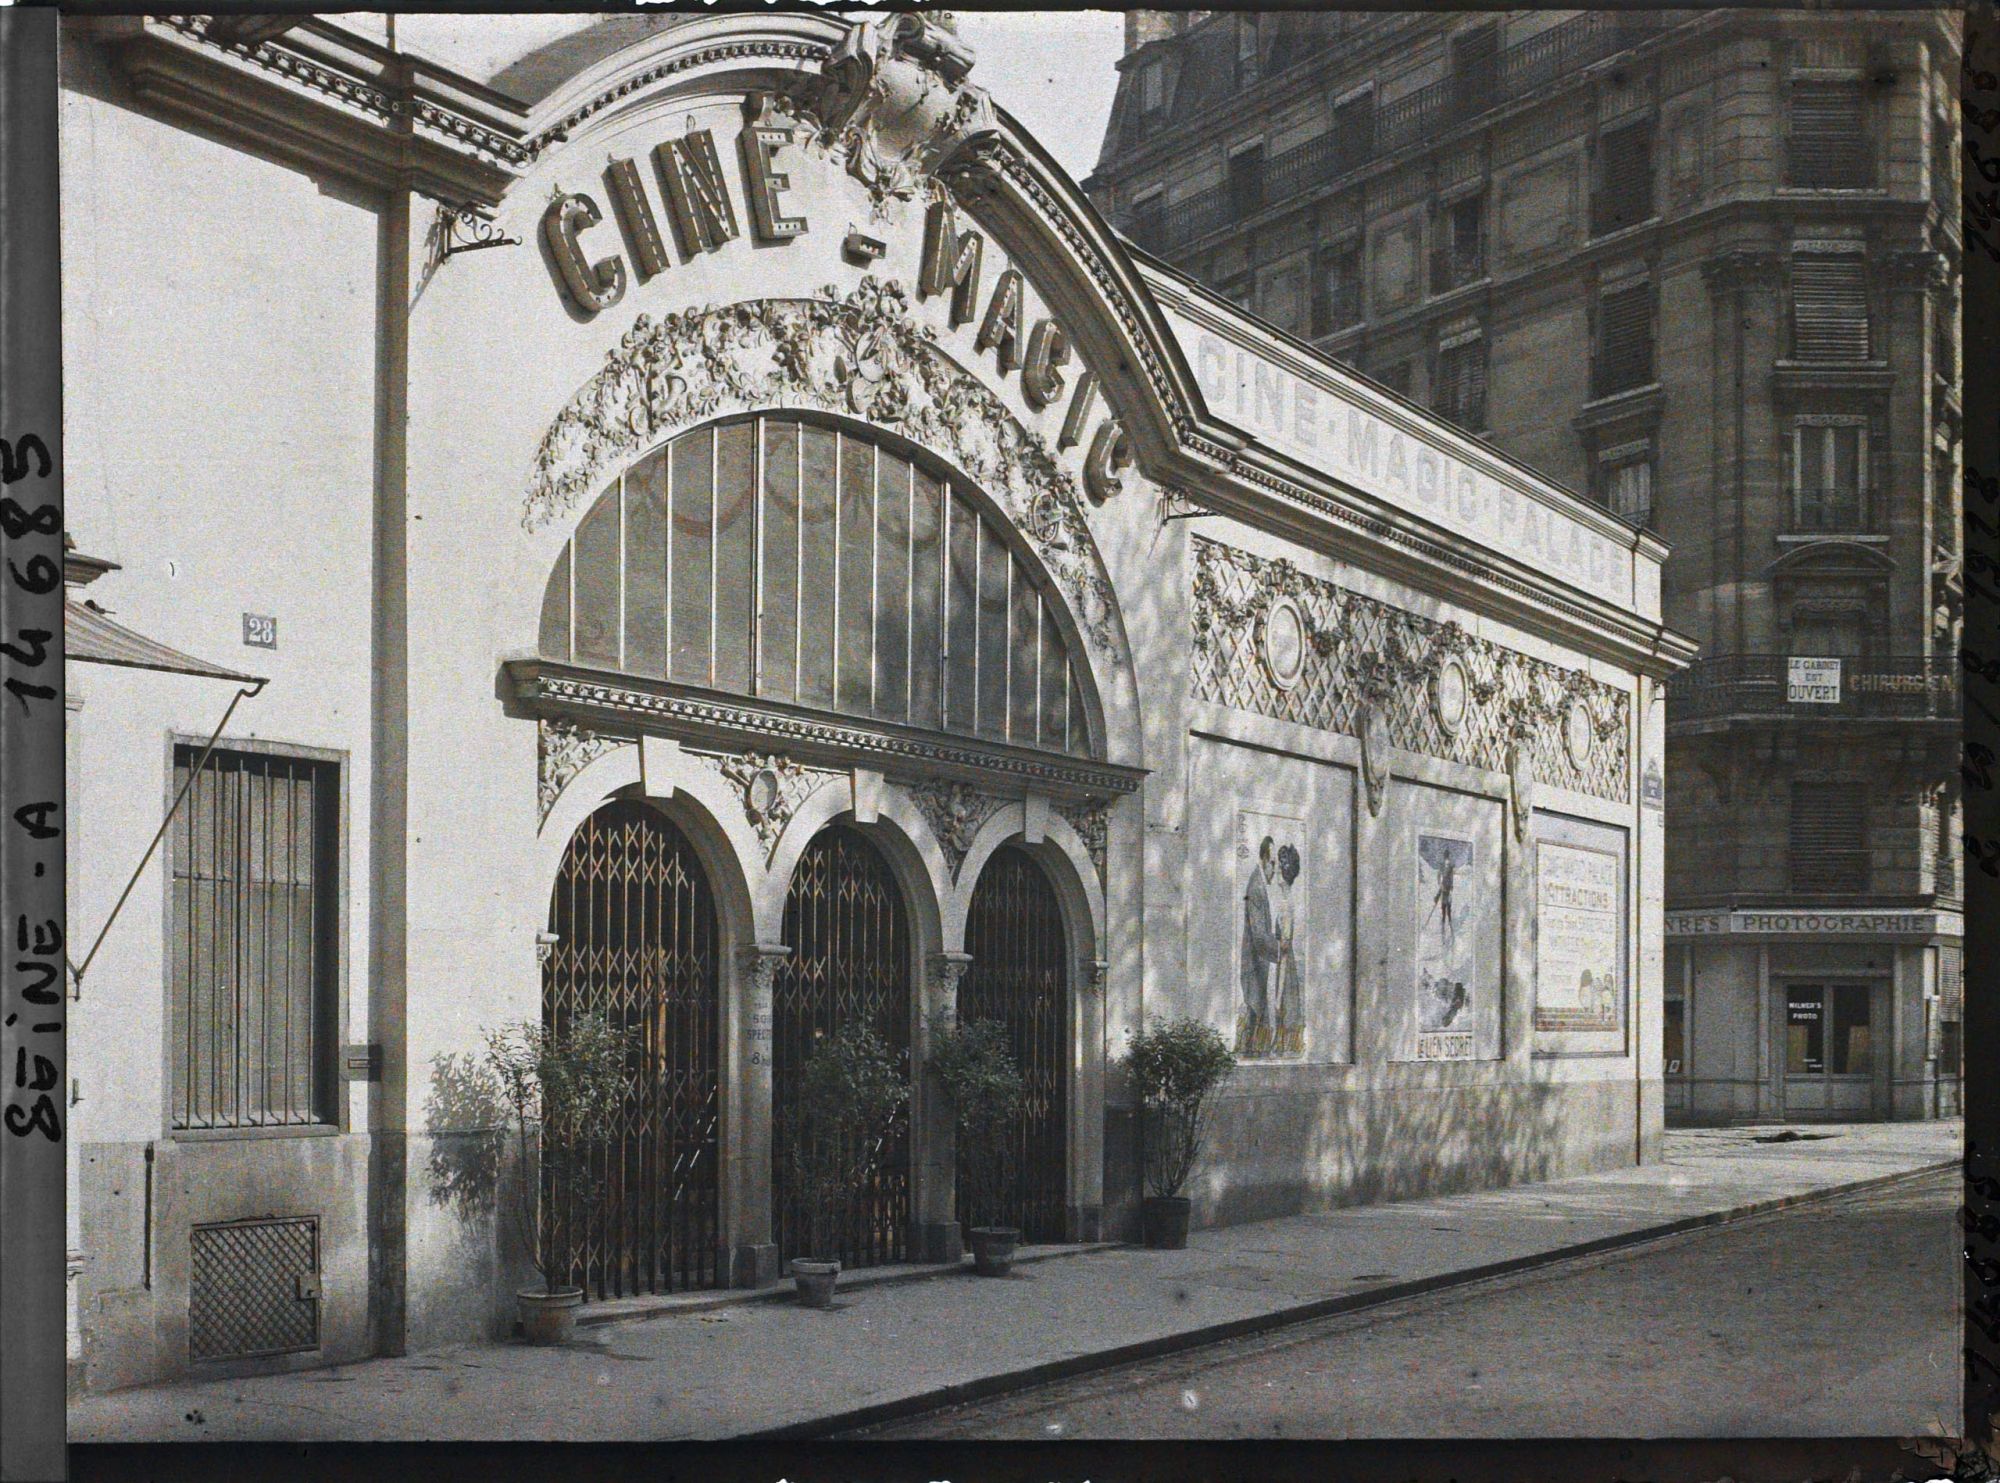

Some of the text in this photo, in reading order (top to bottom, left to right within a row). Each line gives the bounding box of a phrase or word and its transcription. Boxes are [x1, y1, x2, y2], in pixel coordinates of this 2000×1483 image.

[249, 617, 274, 643] 28
[1789, 685, 1838, 700] OUVERT
[1743, 914, 1924, 931] PHOTOGRAPHIE
